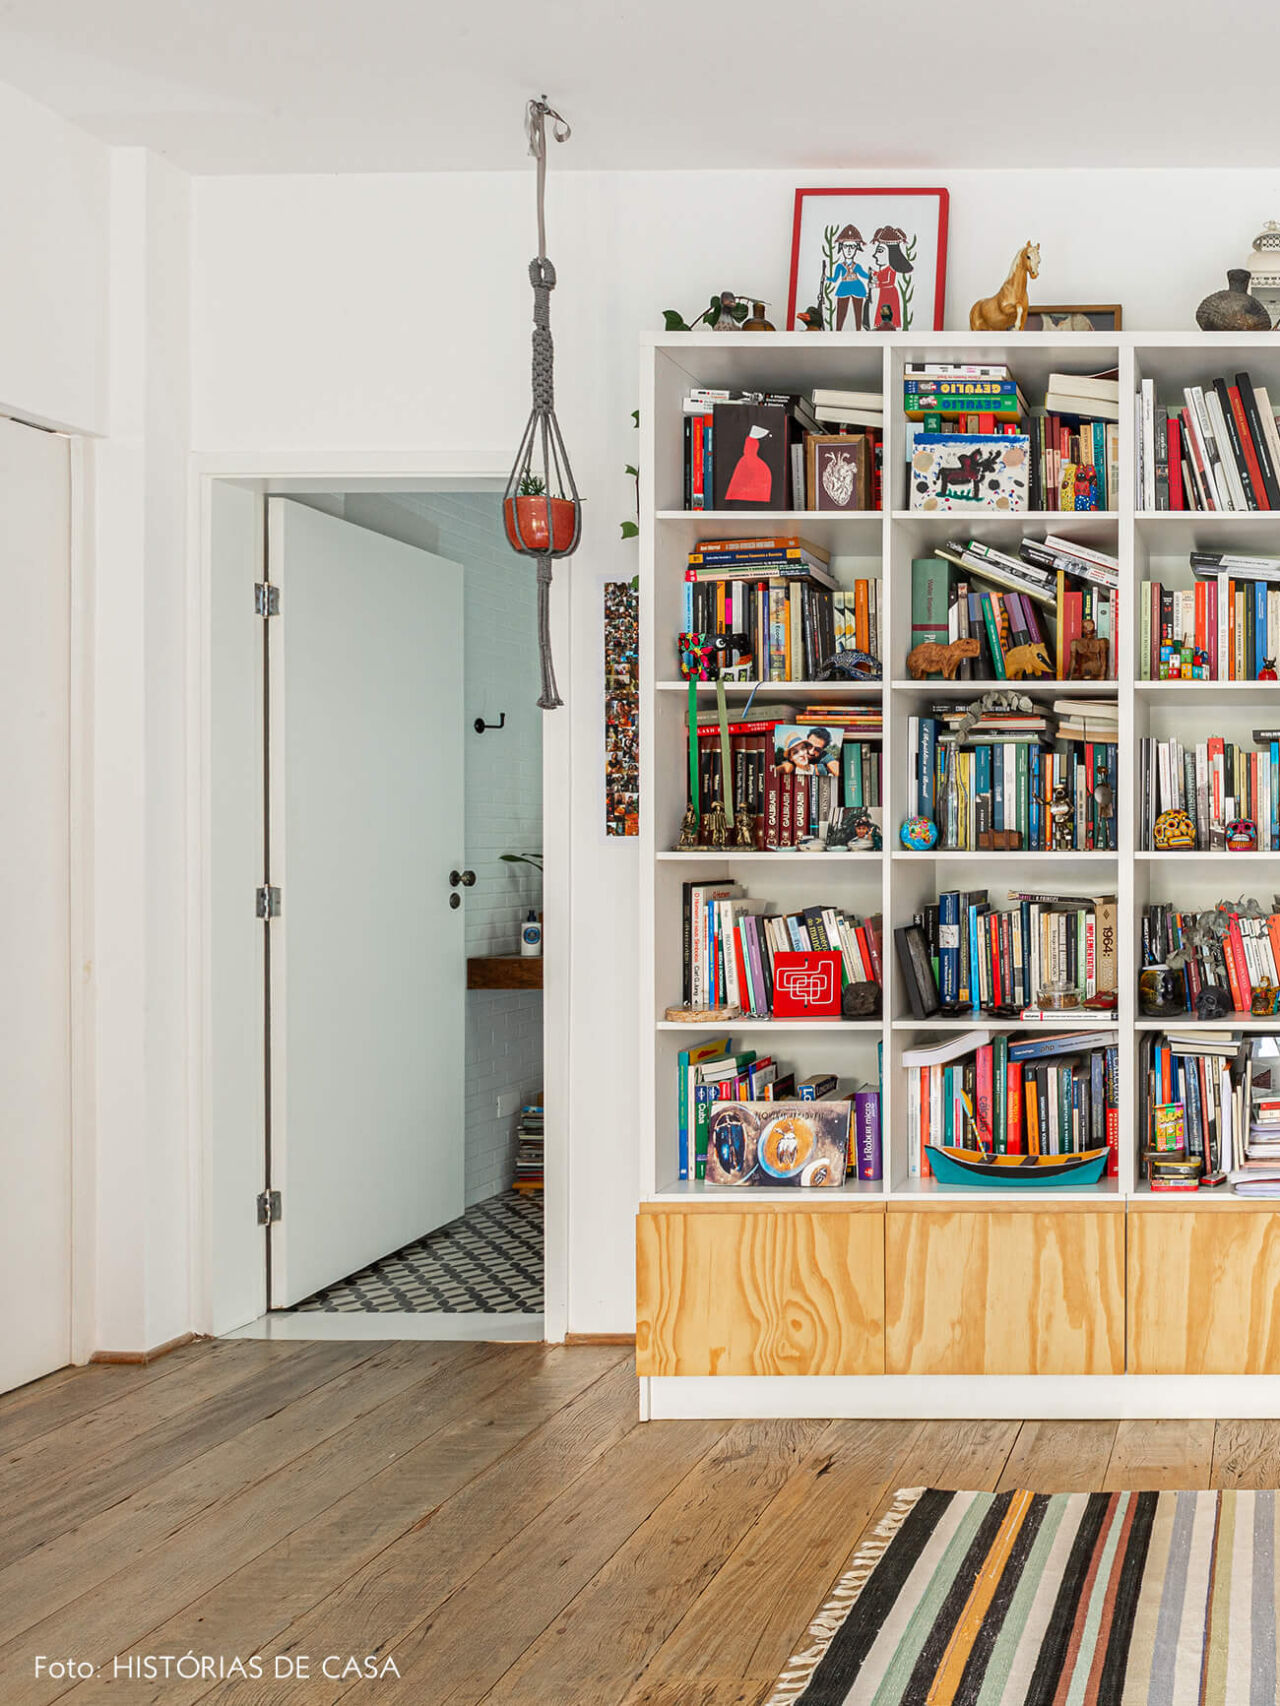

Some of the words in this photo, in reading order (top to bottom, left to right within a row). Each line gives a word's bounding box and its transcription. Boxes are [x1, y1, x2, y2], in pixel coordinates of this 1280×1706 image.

[940, 382, 1001, 394] GETÚLIO
[941, 399, 1001, 410] GETÚLIO
[697, 726, 715, 735] LASH
[809, 926, 822, 951] mund
[817, 925, 829, 951] miséri
[1103, 926, 1113, 957] 1964:
[1086, 923, 1094, 979] IMPLEMENTATION
[698, 1103, 706, 1124] Cuba
